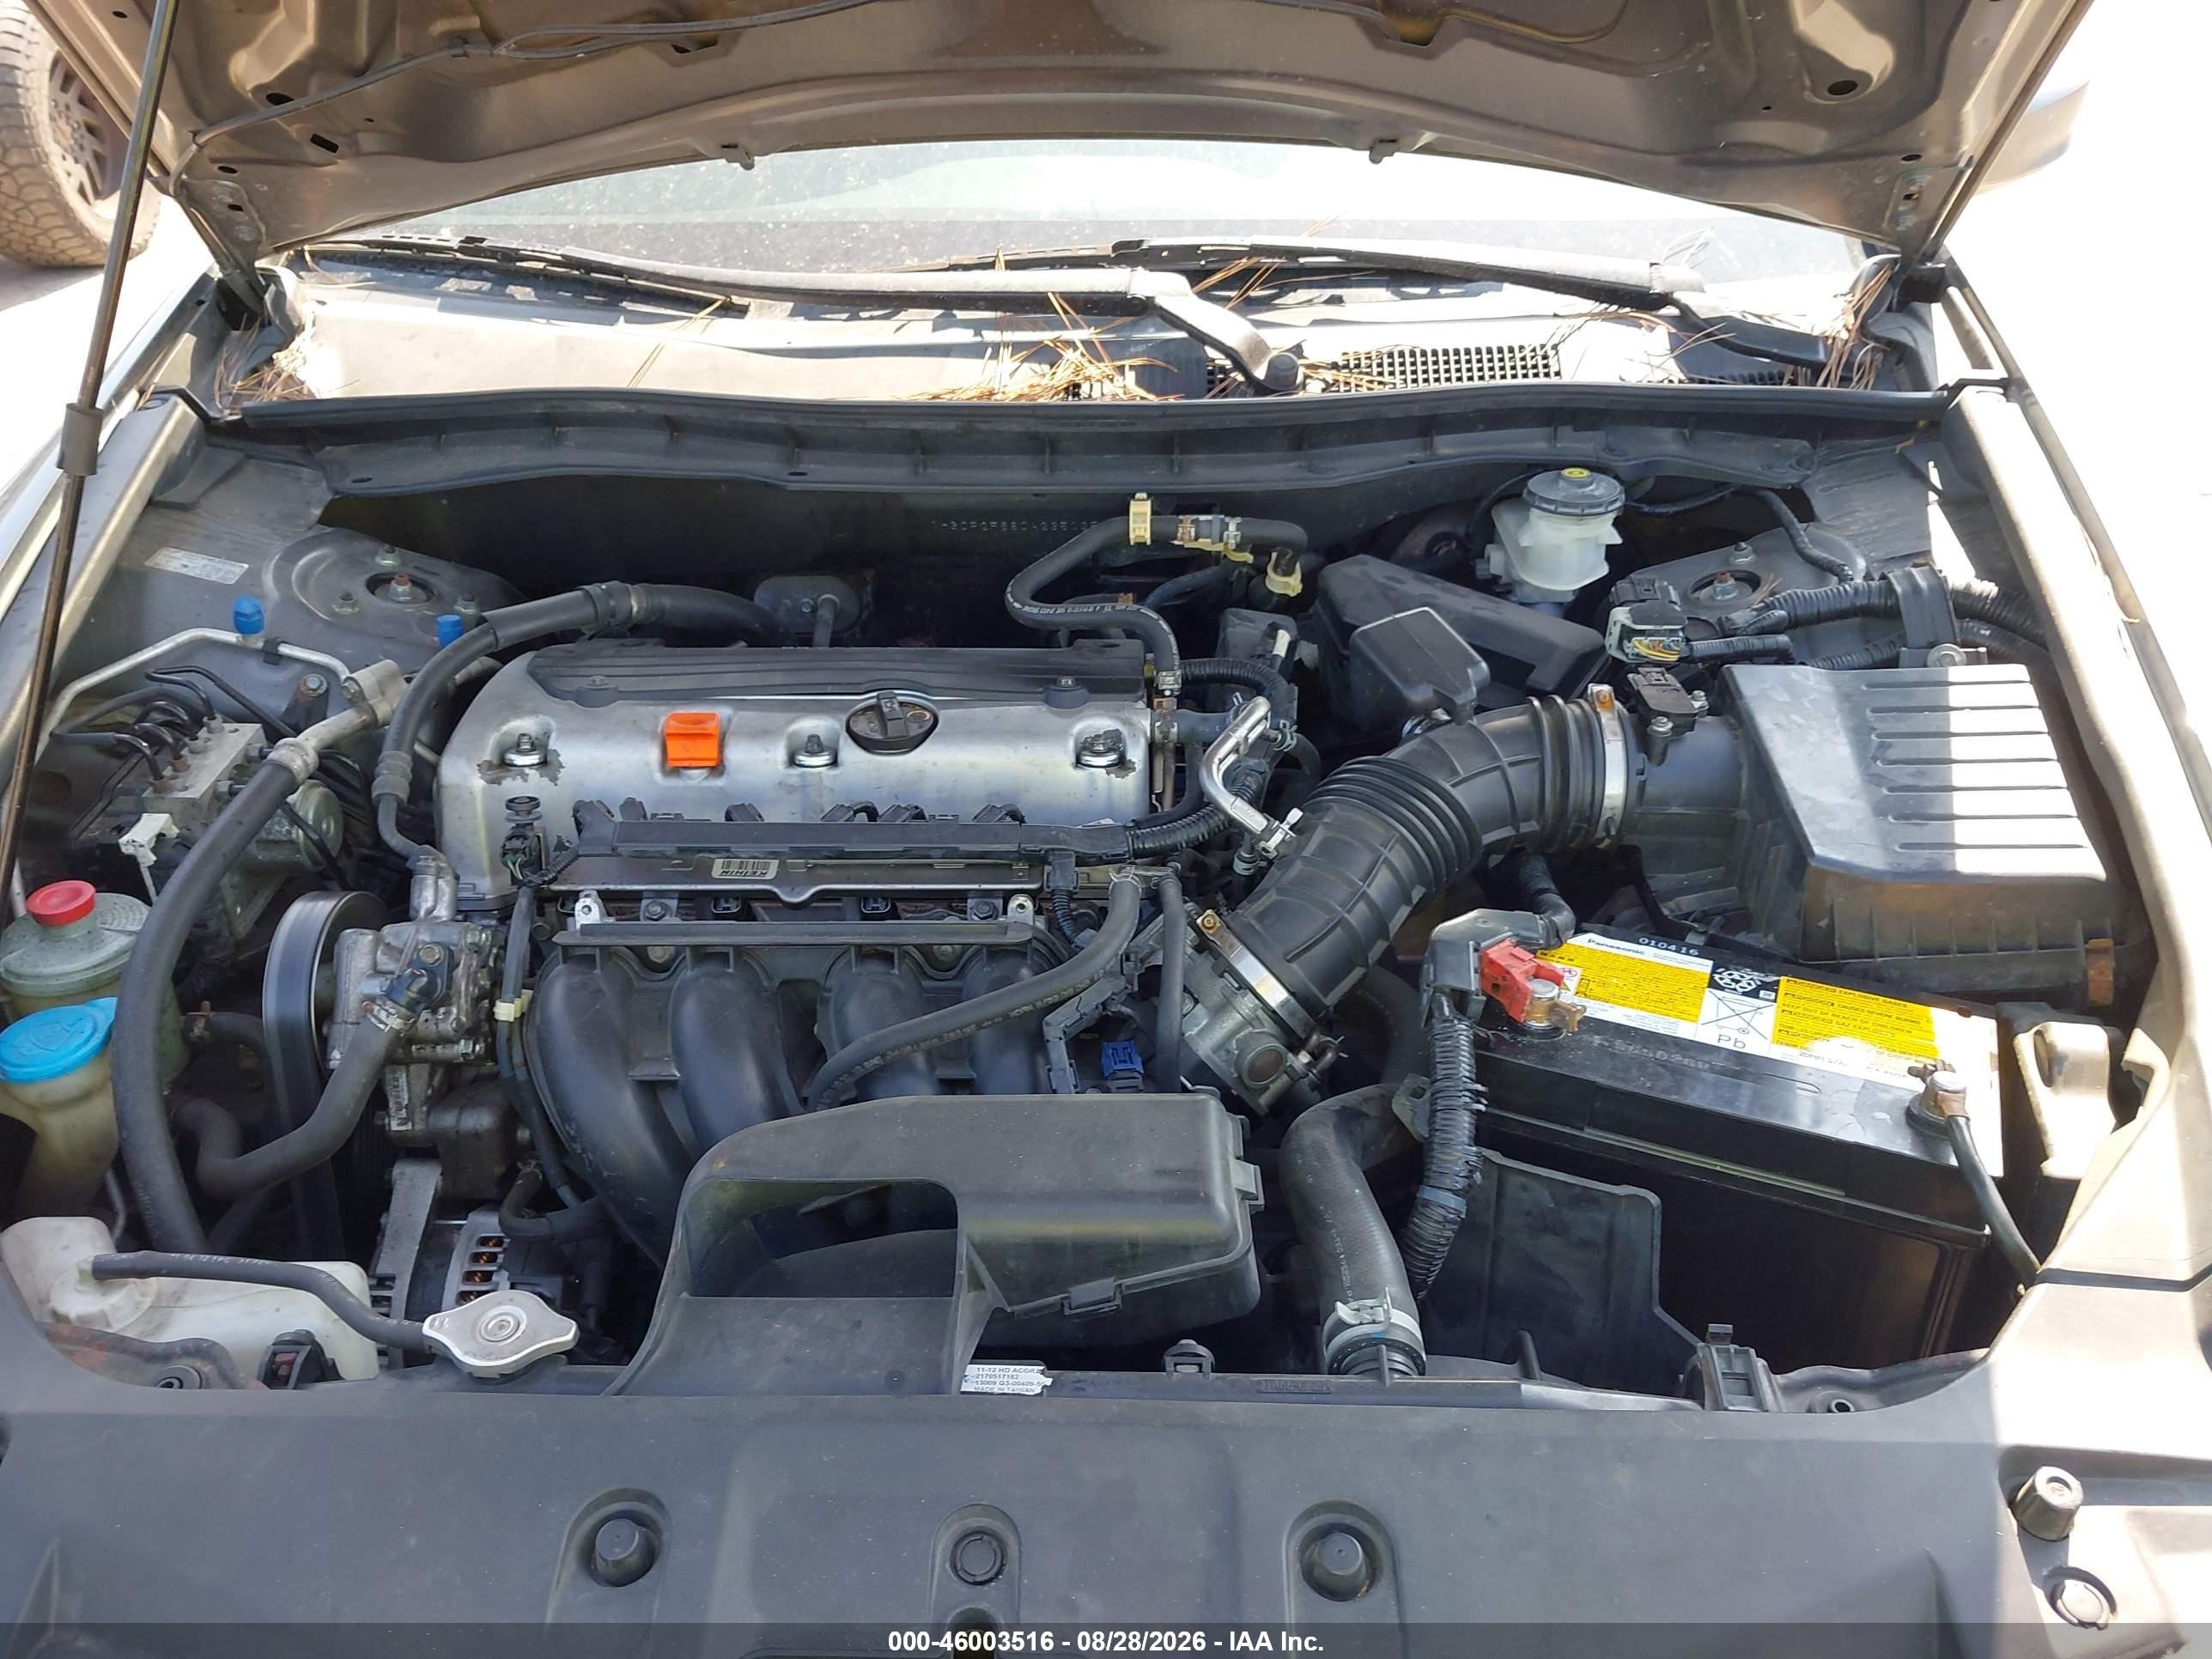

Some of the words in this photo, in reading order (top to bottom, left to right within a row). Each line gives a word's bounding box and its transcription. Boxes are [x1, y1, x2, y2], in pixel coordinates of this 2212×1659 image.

[1588, 938, 1646, 956] Panasonic
[1638, 937, 1699, 956] 010416
[1717, 1034, 1747, 1049] Pb
